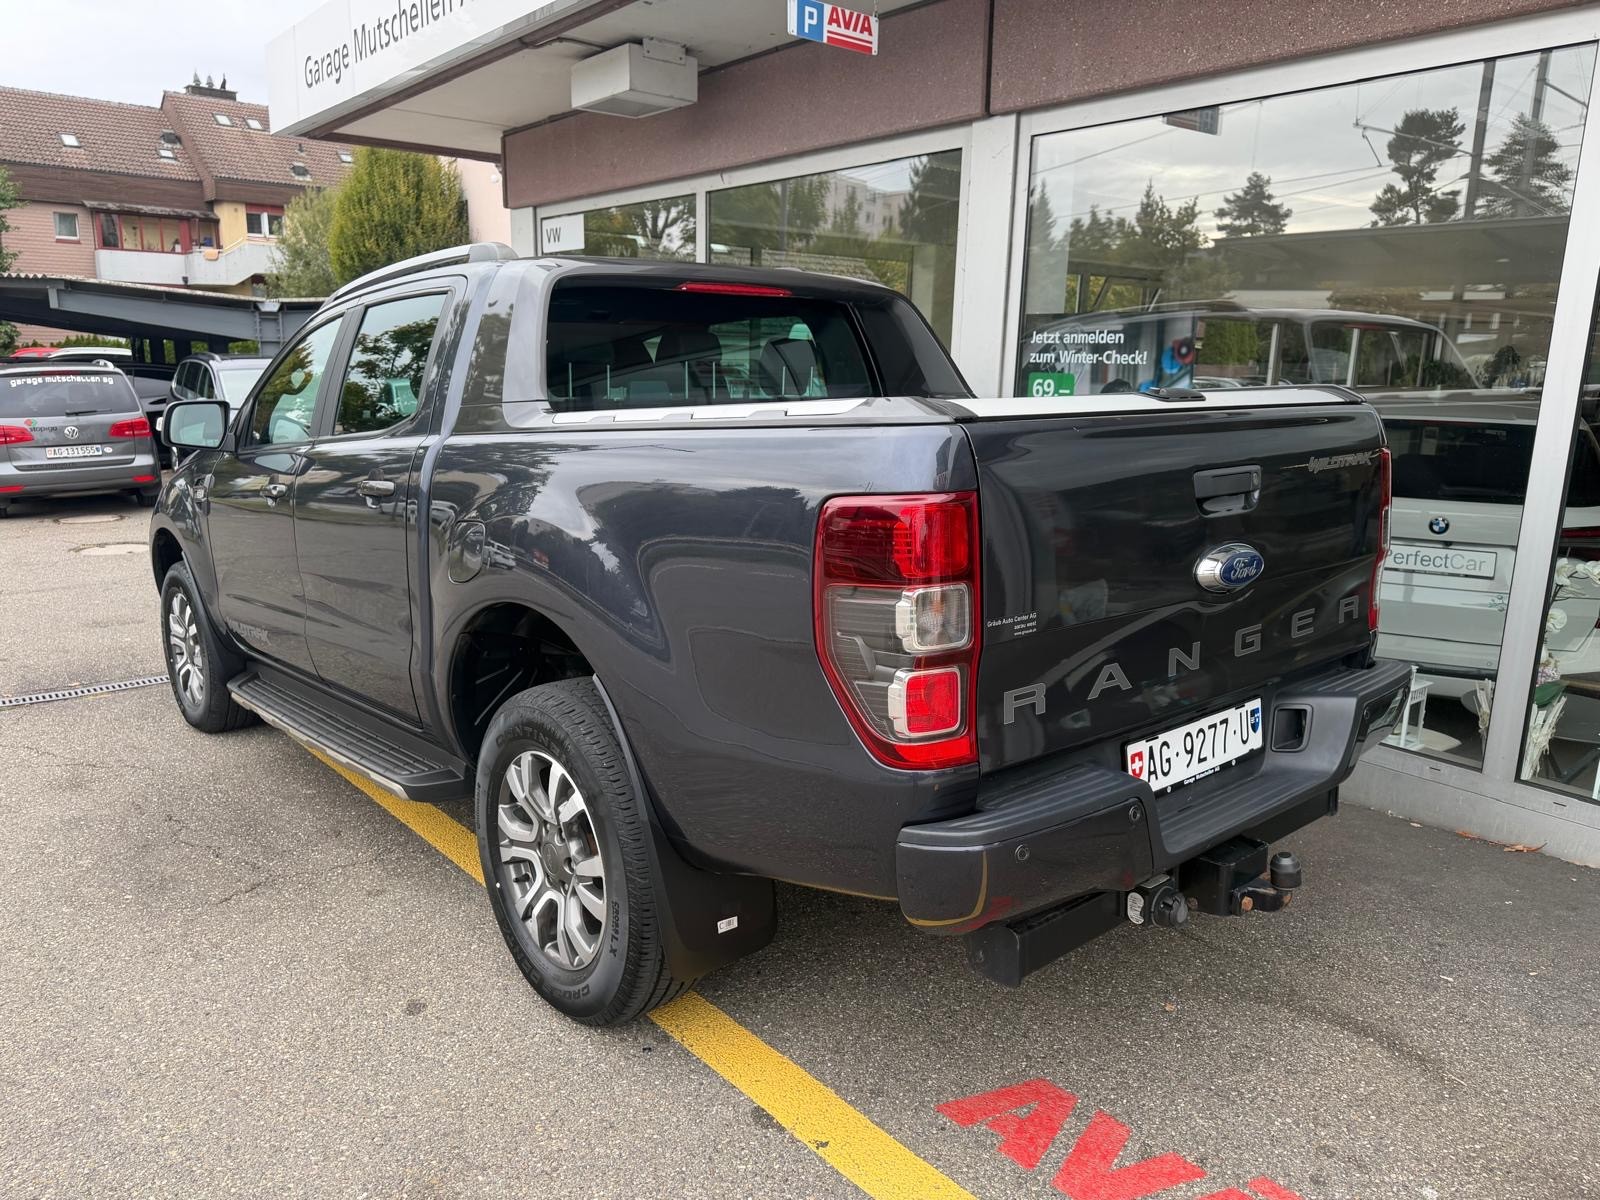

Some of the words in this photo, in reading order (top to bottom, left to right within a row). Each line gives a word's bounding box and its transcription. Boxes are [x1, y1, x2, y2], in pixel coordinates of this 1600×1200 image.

[804, 5, 818, 33] P
[827, 5, 873, 36] AVIA
[304, 43, 349, 88] Garage
[546, 227, 561, 243] VW
[1031, 330, 1060, 344] Jetzt
[1063, 329, 1125, 344] anmelden
[1029, 352, 1055, 364] zum
[1059, 350, 1147, 365] Winter-Check!
[10, 377, 43, 388] garage
[45, 375, 100, 384] mutschellen
[103, 377, 114, 385] ag
[1231, 557, 1257, 580] Ford
[1388, 550, 1487, 572] erfectCar
[1003, 595, 1360, 725] RANGER
[935, 1077, 1304, 1200] AV
